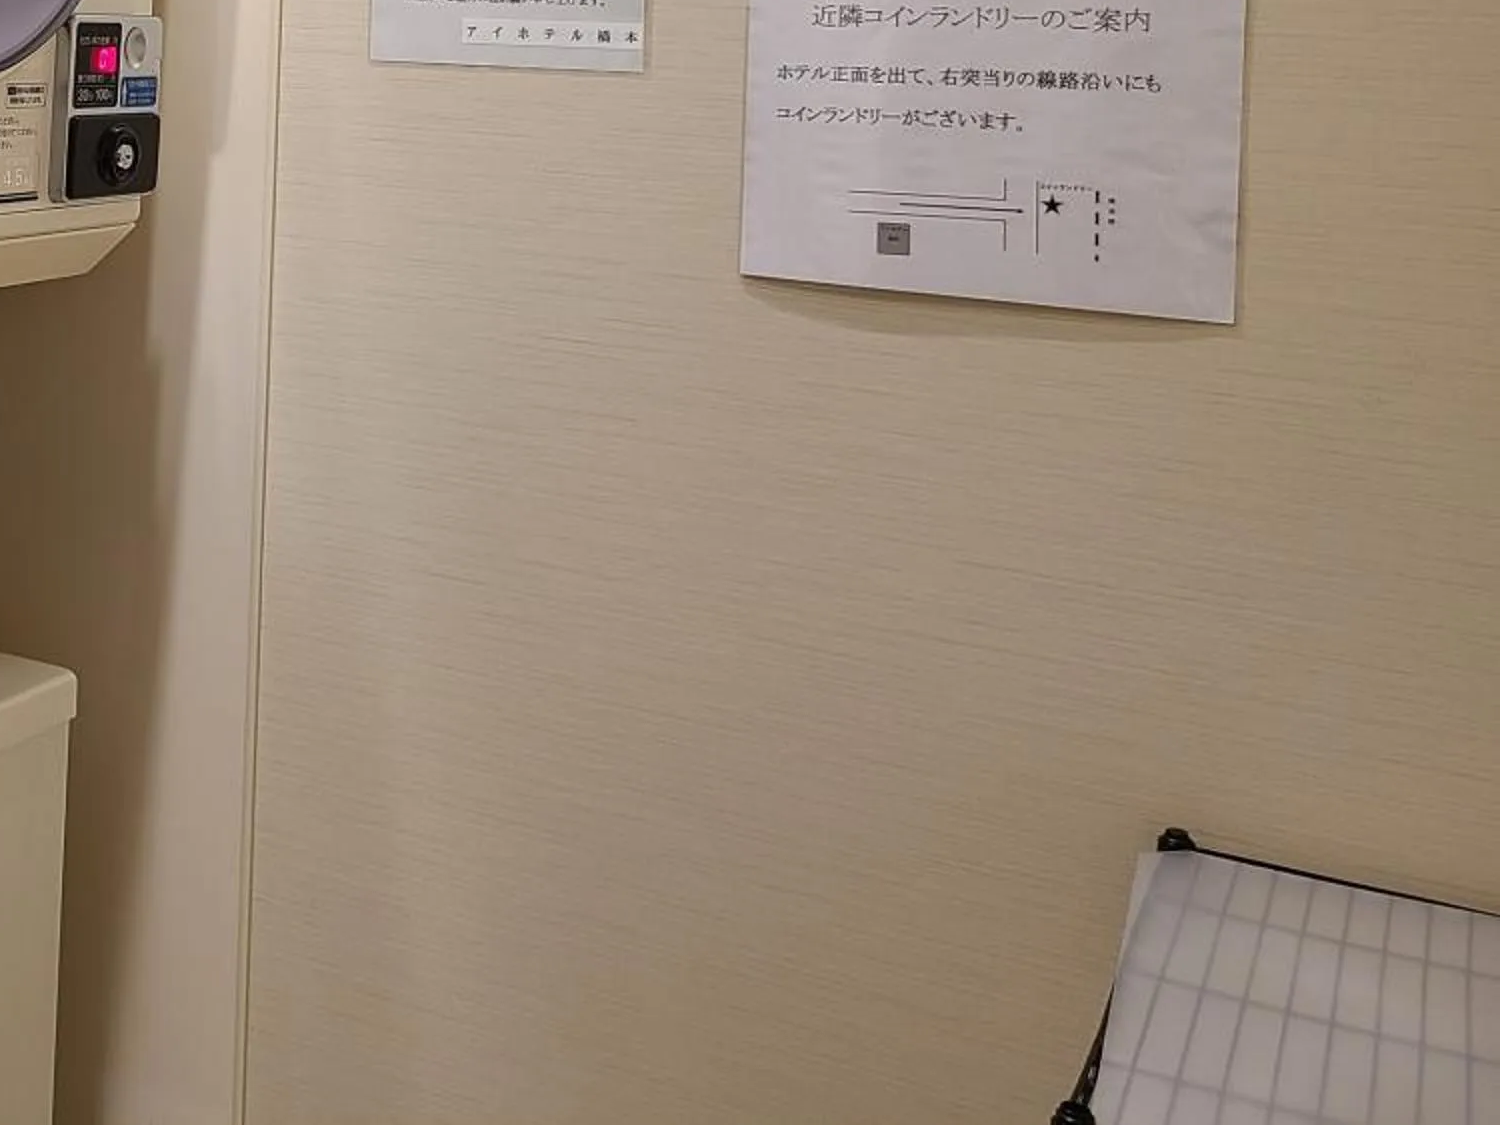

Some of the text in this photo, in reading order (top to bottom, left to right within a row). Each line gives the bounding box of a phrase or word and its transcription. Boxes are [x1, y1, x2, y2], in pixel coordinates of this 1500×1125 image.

[811, 3, 1151, 34] 近隣コインランドリーのご案内
[776, 65, 1162, 94] ホテル正面を出て、右突当りの線路沿いにも
[776, 105, 1026, 132] コインランドリーがございます。
